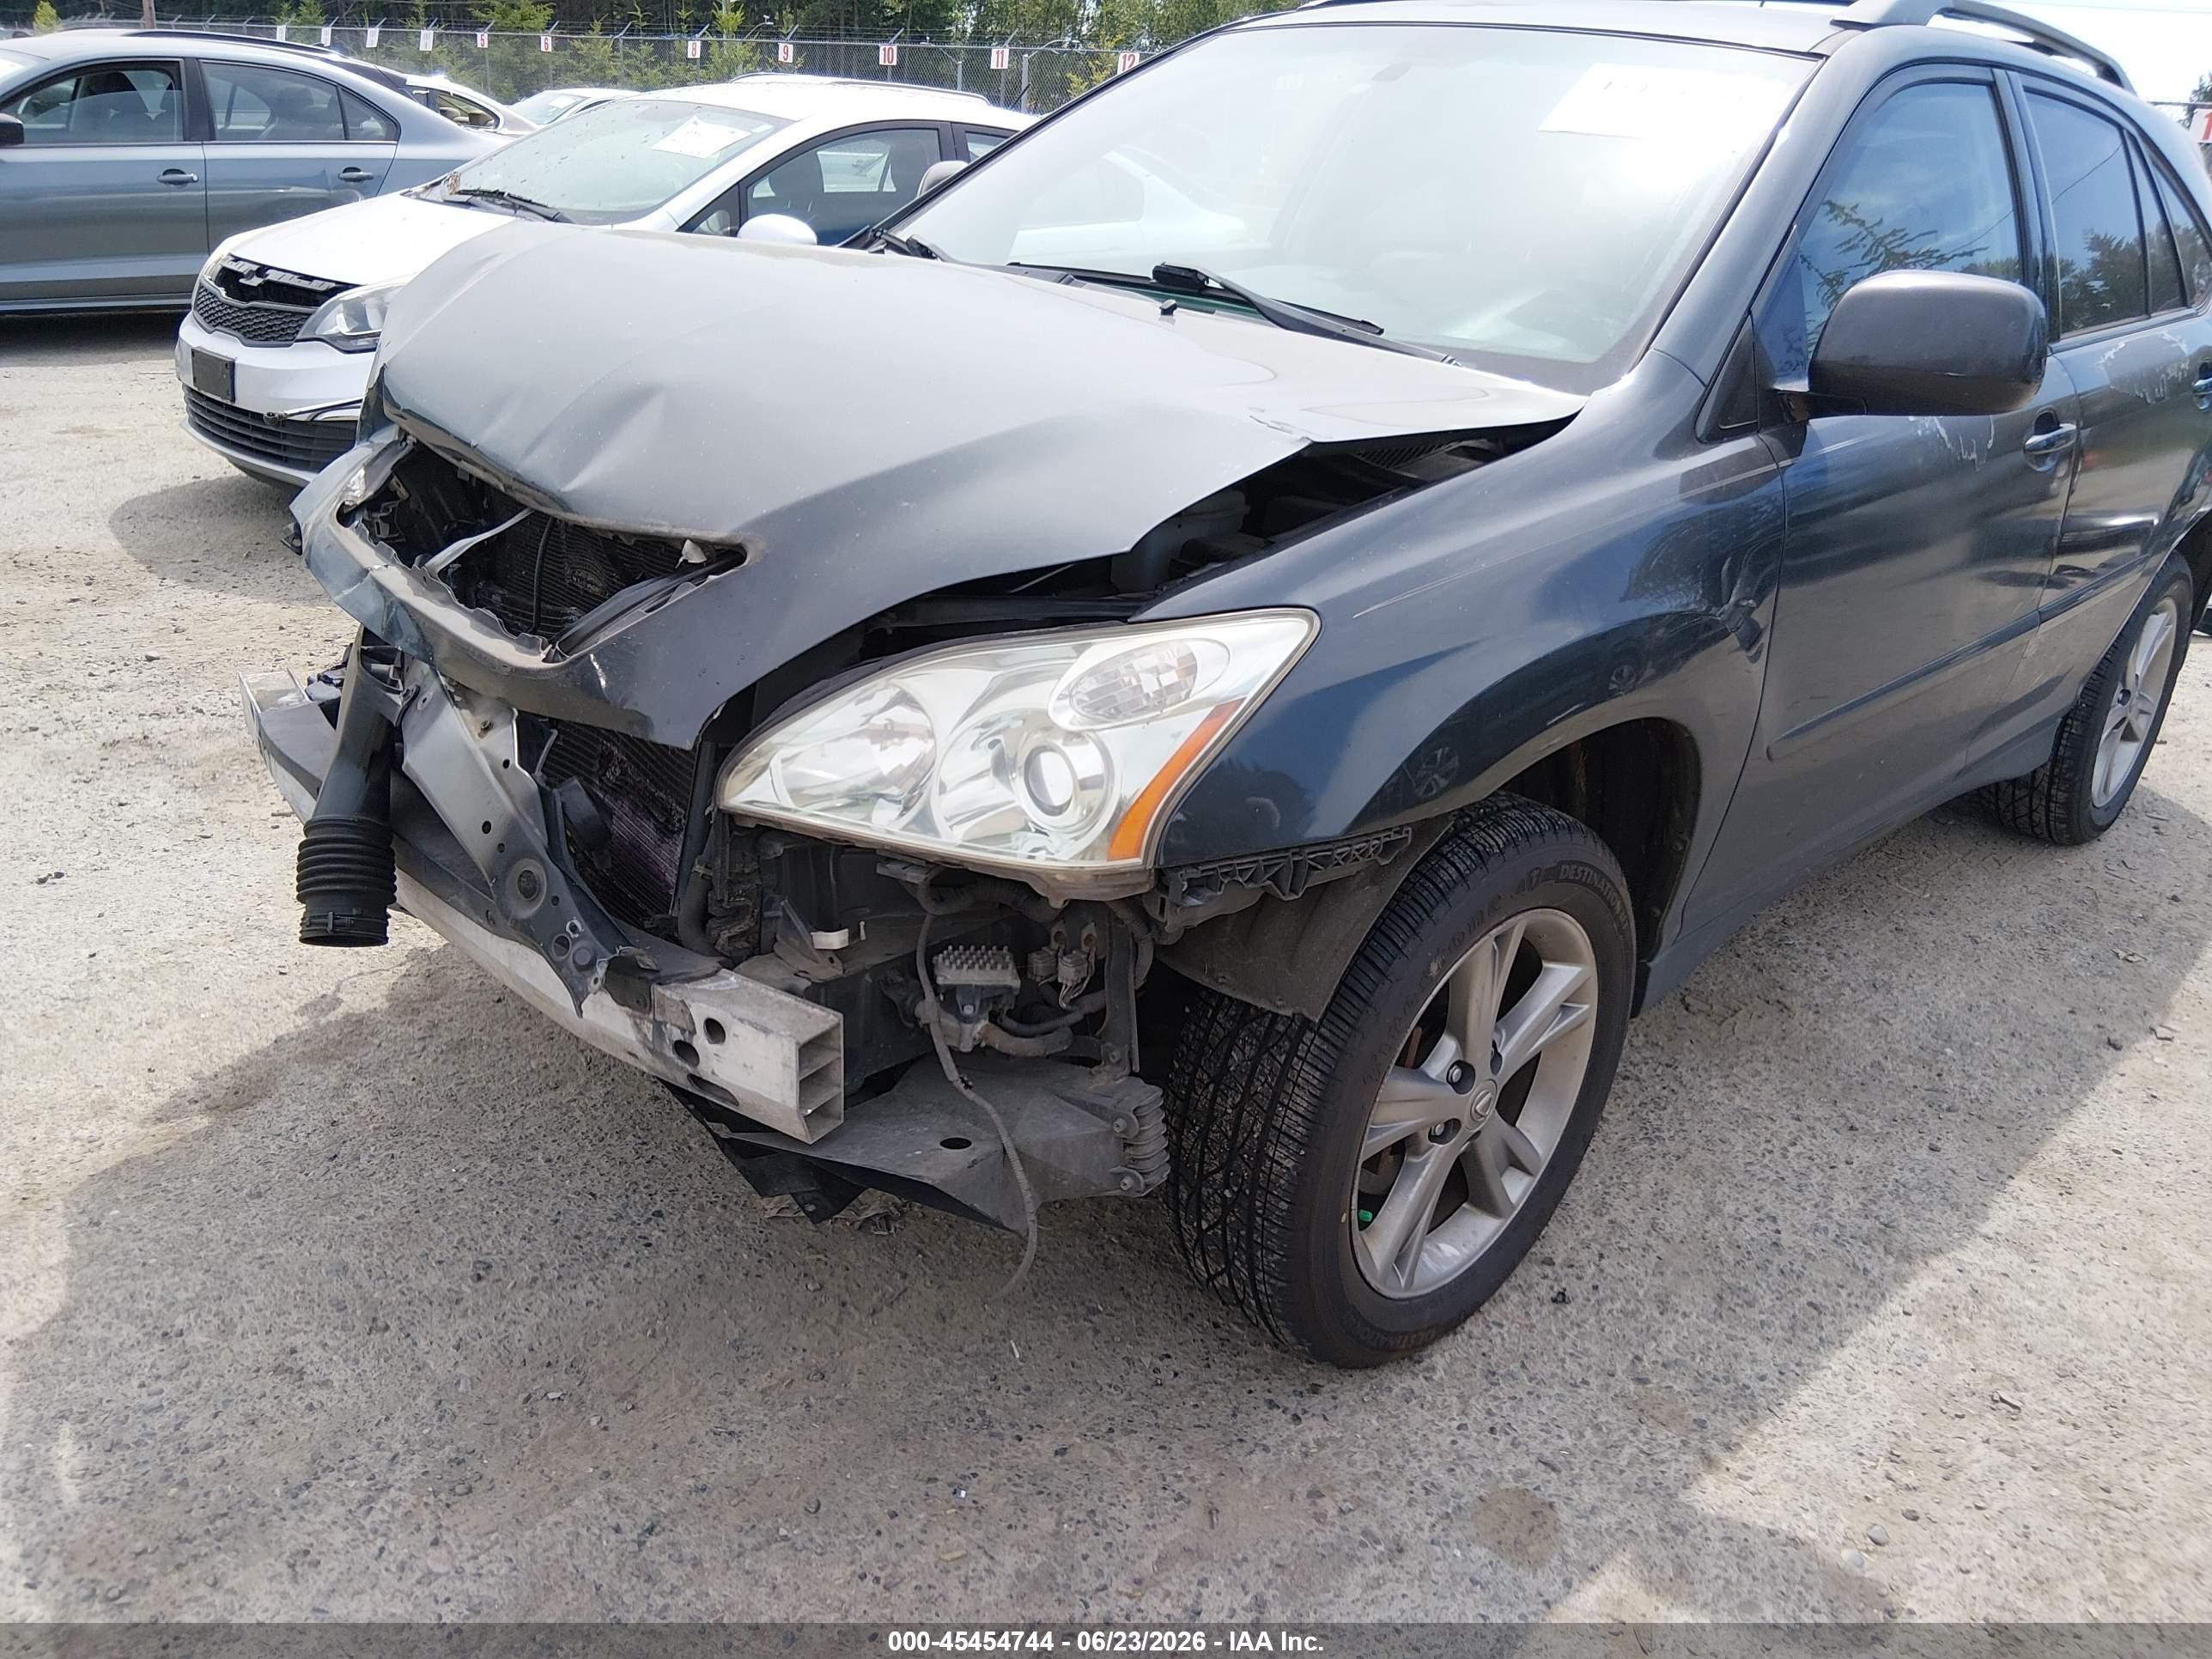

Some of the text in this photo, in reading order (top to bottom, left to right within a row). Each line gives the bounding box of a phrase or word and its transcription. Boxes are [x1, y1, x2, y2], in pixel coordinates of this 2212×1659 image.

[480, 33, 485, 46] 5
[544, 38, 549, 51] 6
[691, 42, 697, 57] 8
[782, 45, 789, 61] 9
[883, 46, 894, 64] 10
[995, 50, 1005, 68] 11
[1122, 53, 1135, 71] 12
